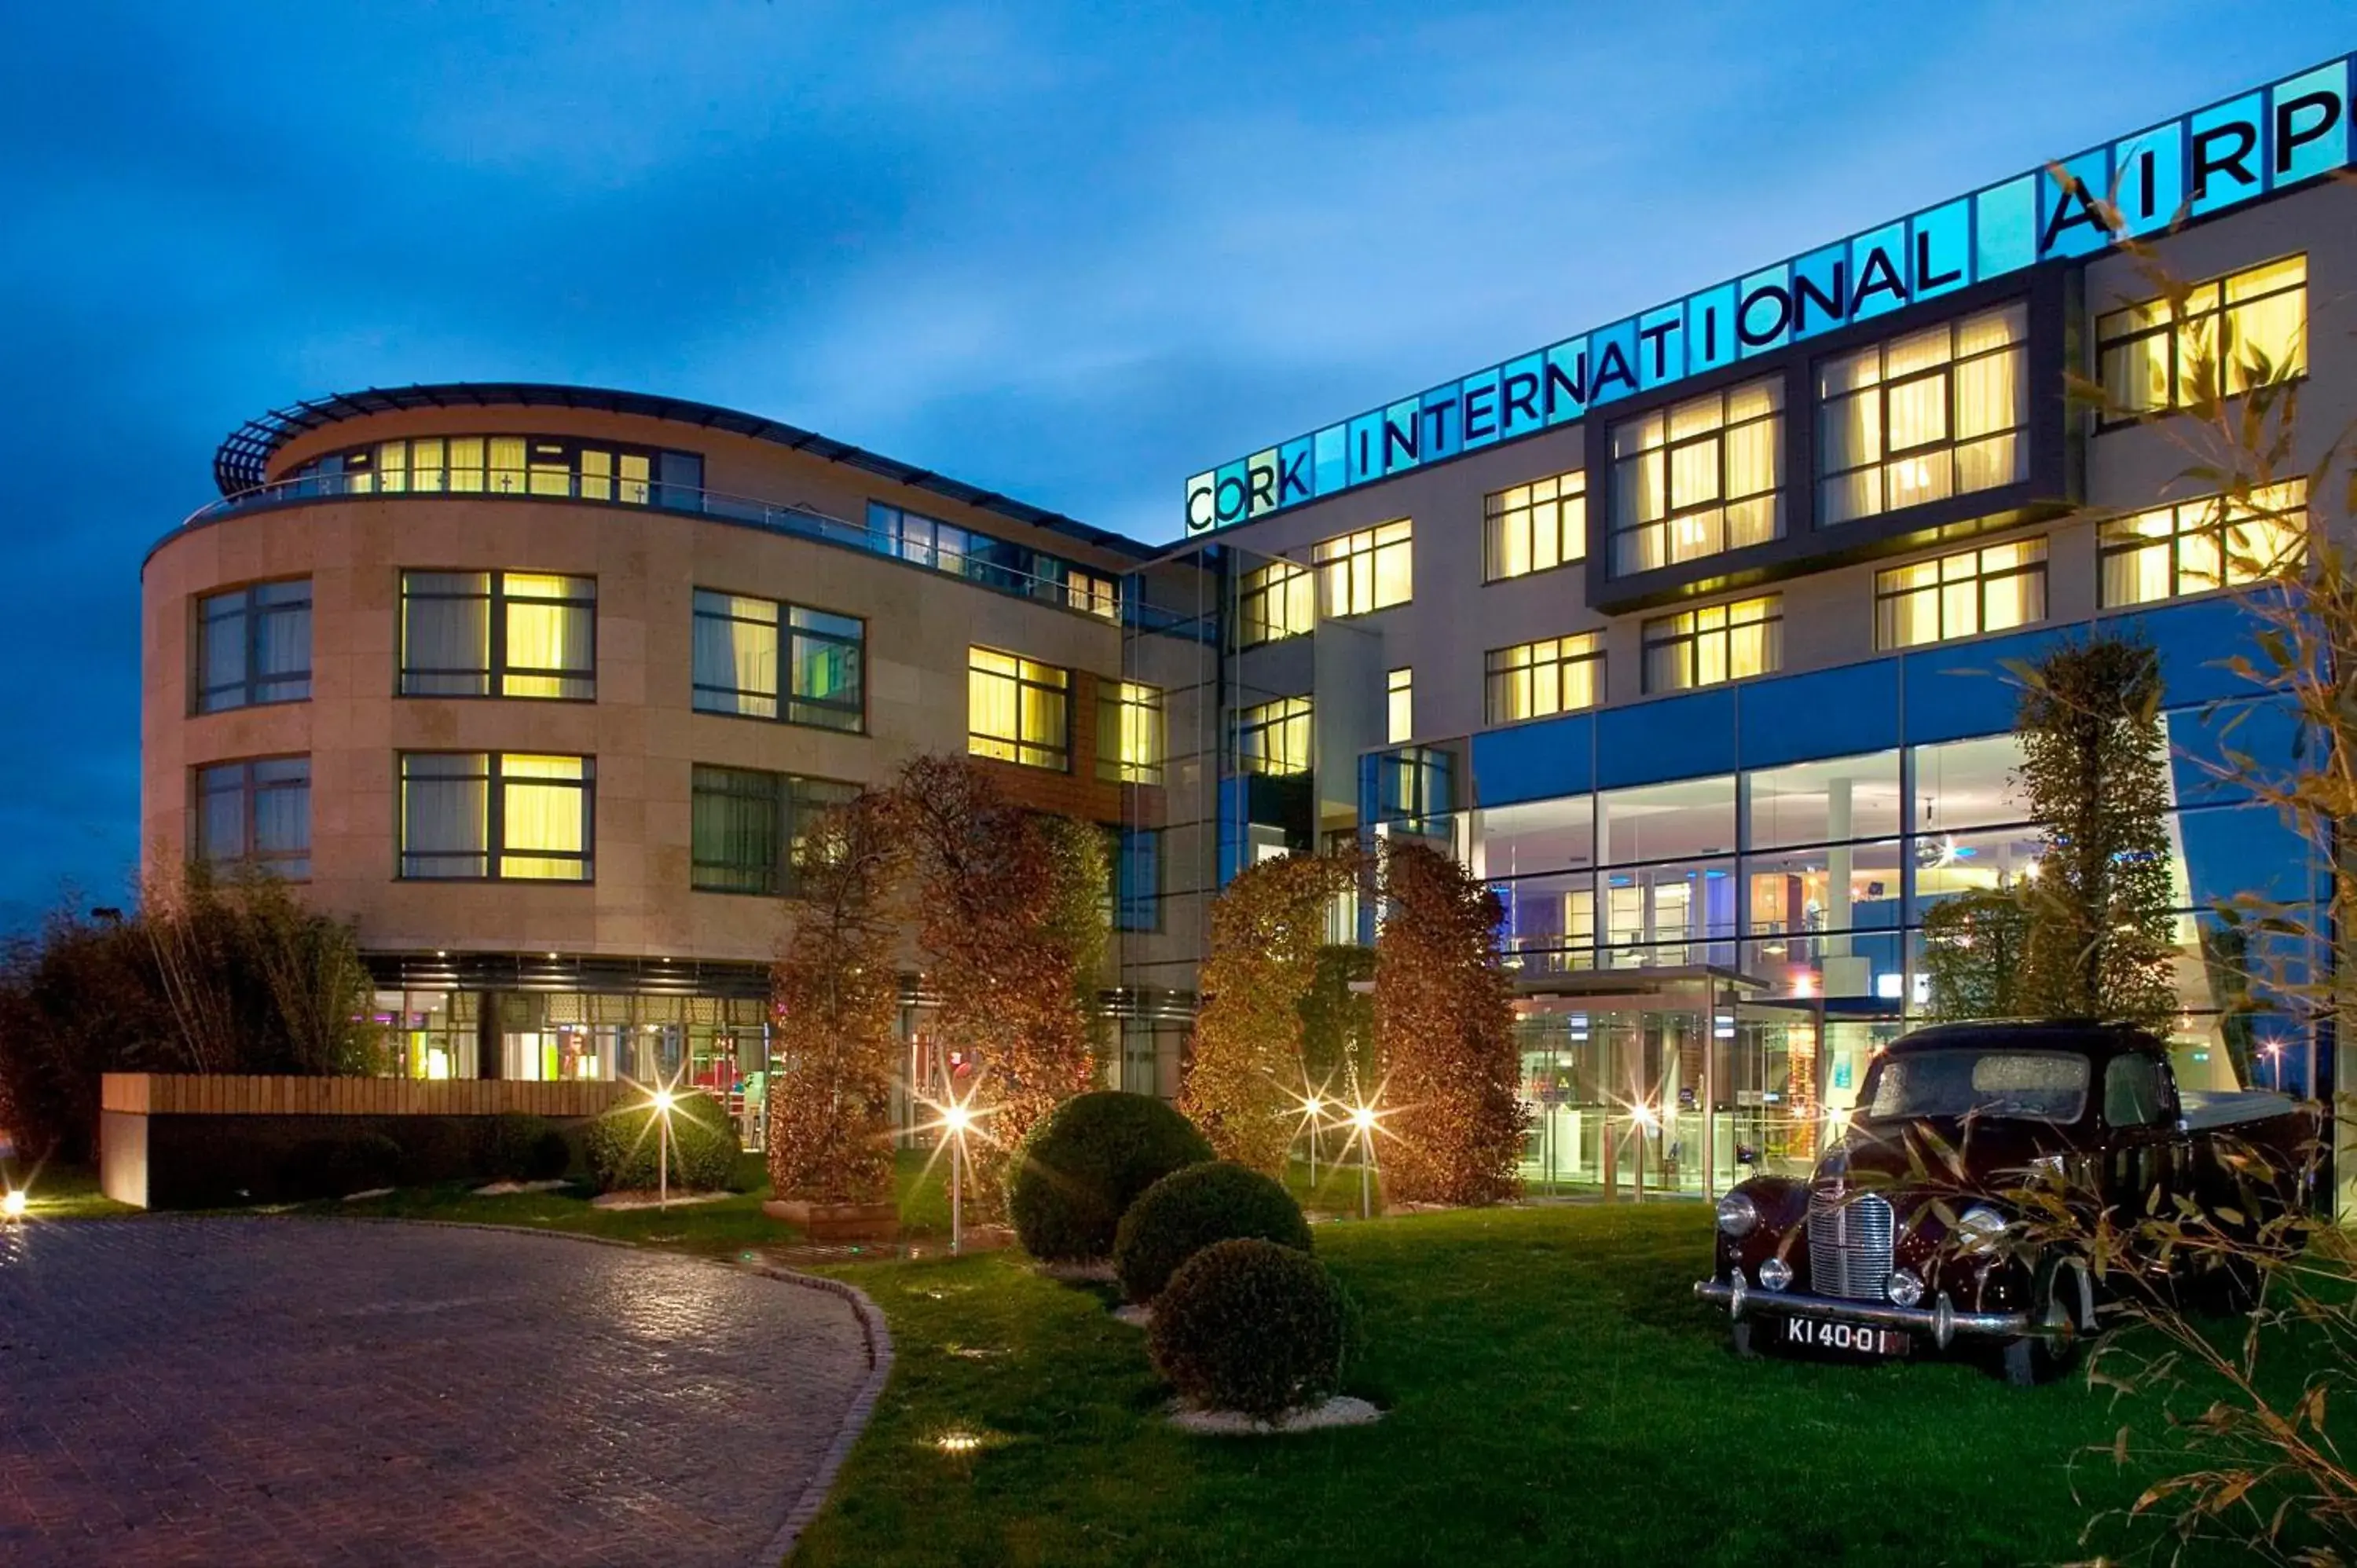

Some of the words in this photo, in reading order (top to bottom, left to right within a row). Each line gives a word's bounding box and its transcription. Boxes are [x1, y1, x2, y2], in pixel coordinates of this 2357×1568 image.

[1185, 449, 1310, 531] CORK
[1360, 229, 1962, 475] INTERNATIONAL
[2041, 90, 2357, 255] AIRP
